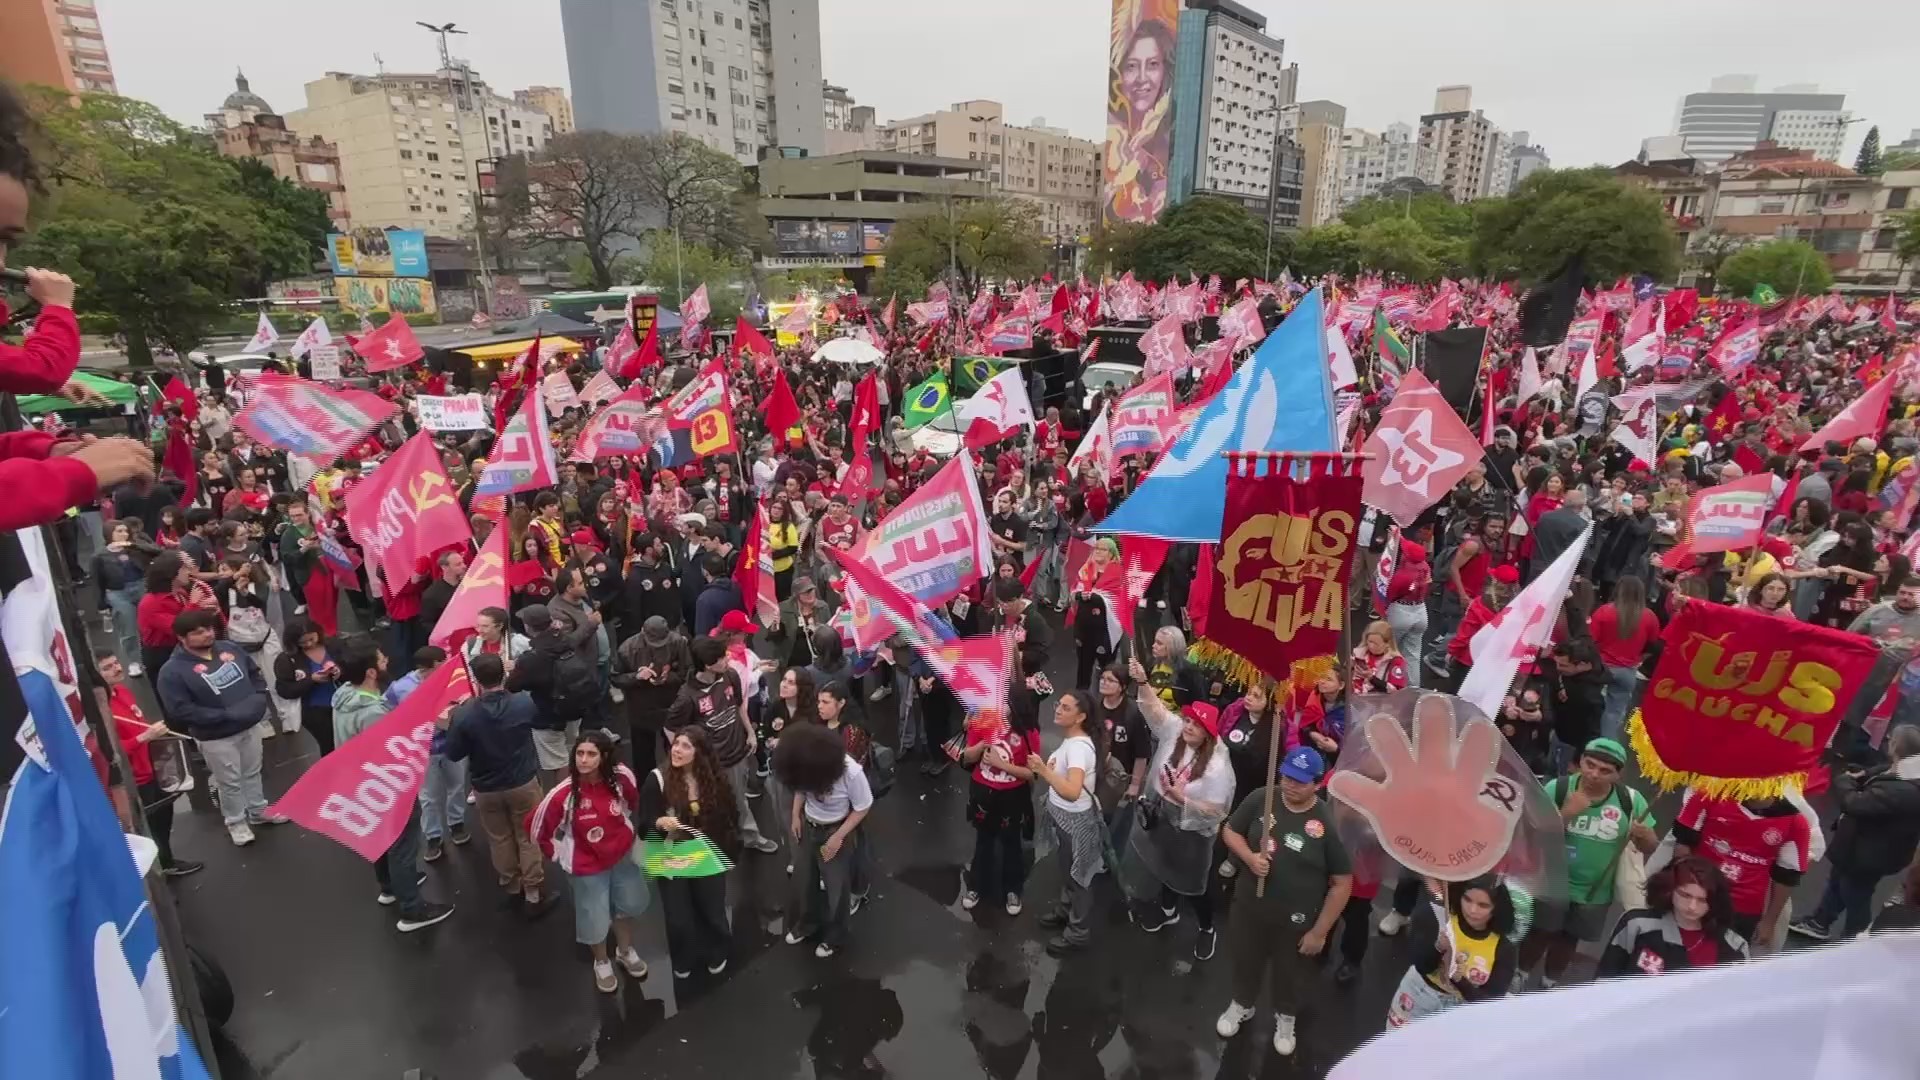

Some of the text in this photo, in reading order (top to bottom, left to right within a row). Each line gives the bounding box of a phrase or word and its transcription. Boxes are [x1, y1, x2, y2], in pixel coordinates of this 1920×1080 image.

[694, 414, 719, 445] 13
[1653, 677, 1815, 749] GAÚCHA
[1690, 640, 1842, 715] UJS
